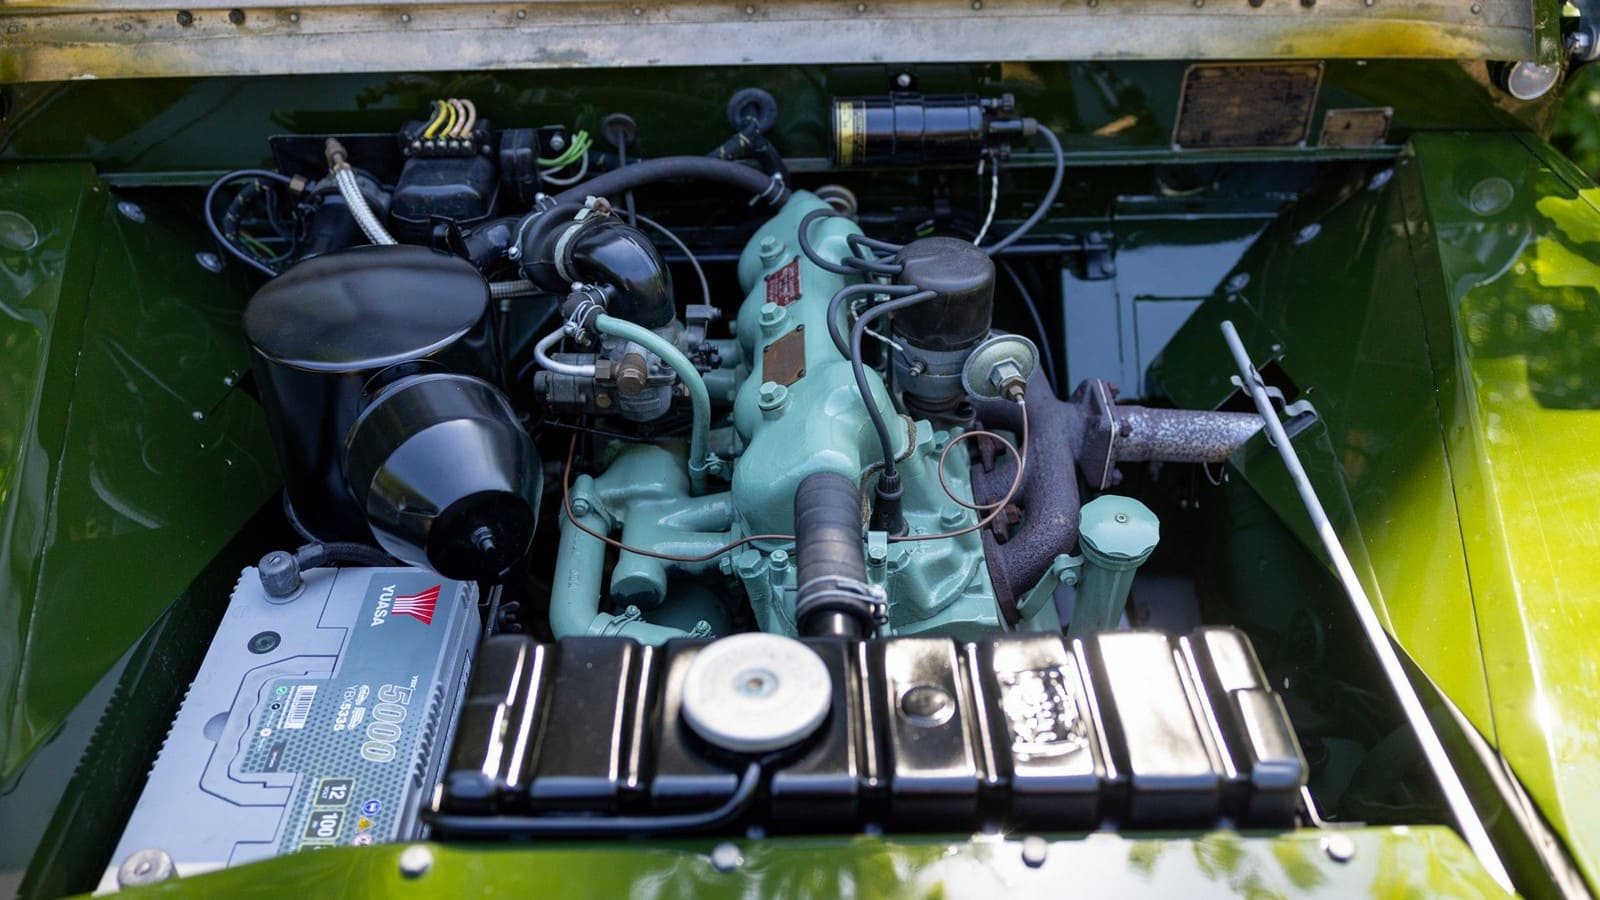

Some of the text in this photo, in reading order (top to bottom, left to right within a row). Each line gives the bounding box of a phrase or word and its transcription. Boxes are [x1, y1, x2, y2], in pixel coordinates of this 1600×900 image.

[370, 584, 397, 627] YUASA
[333, 684, 359, 731] YBX5335
[360, 684, 412, 763] 5000
[329, 784, 347, 800] 12
[317, 812, 339, 837] 100
